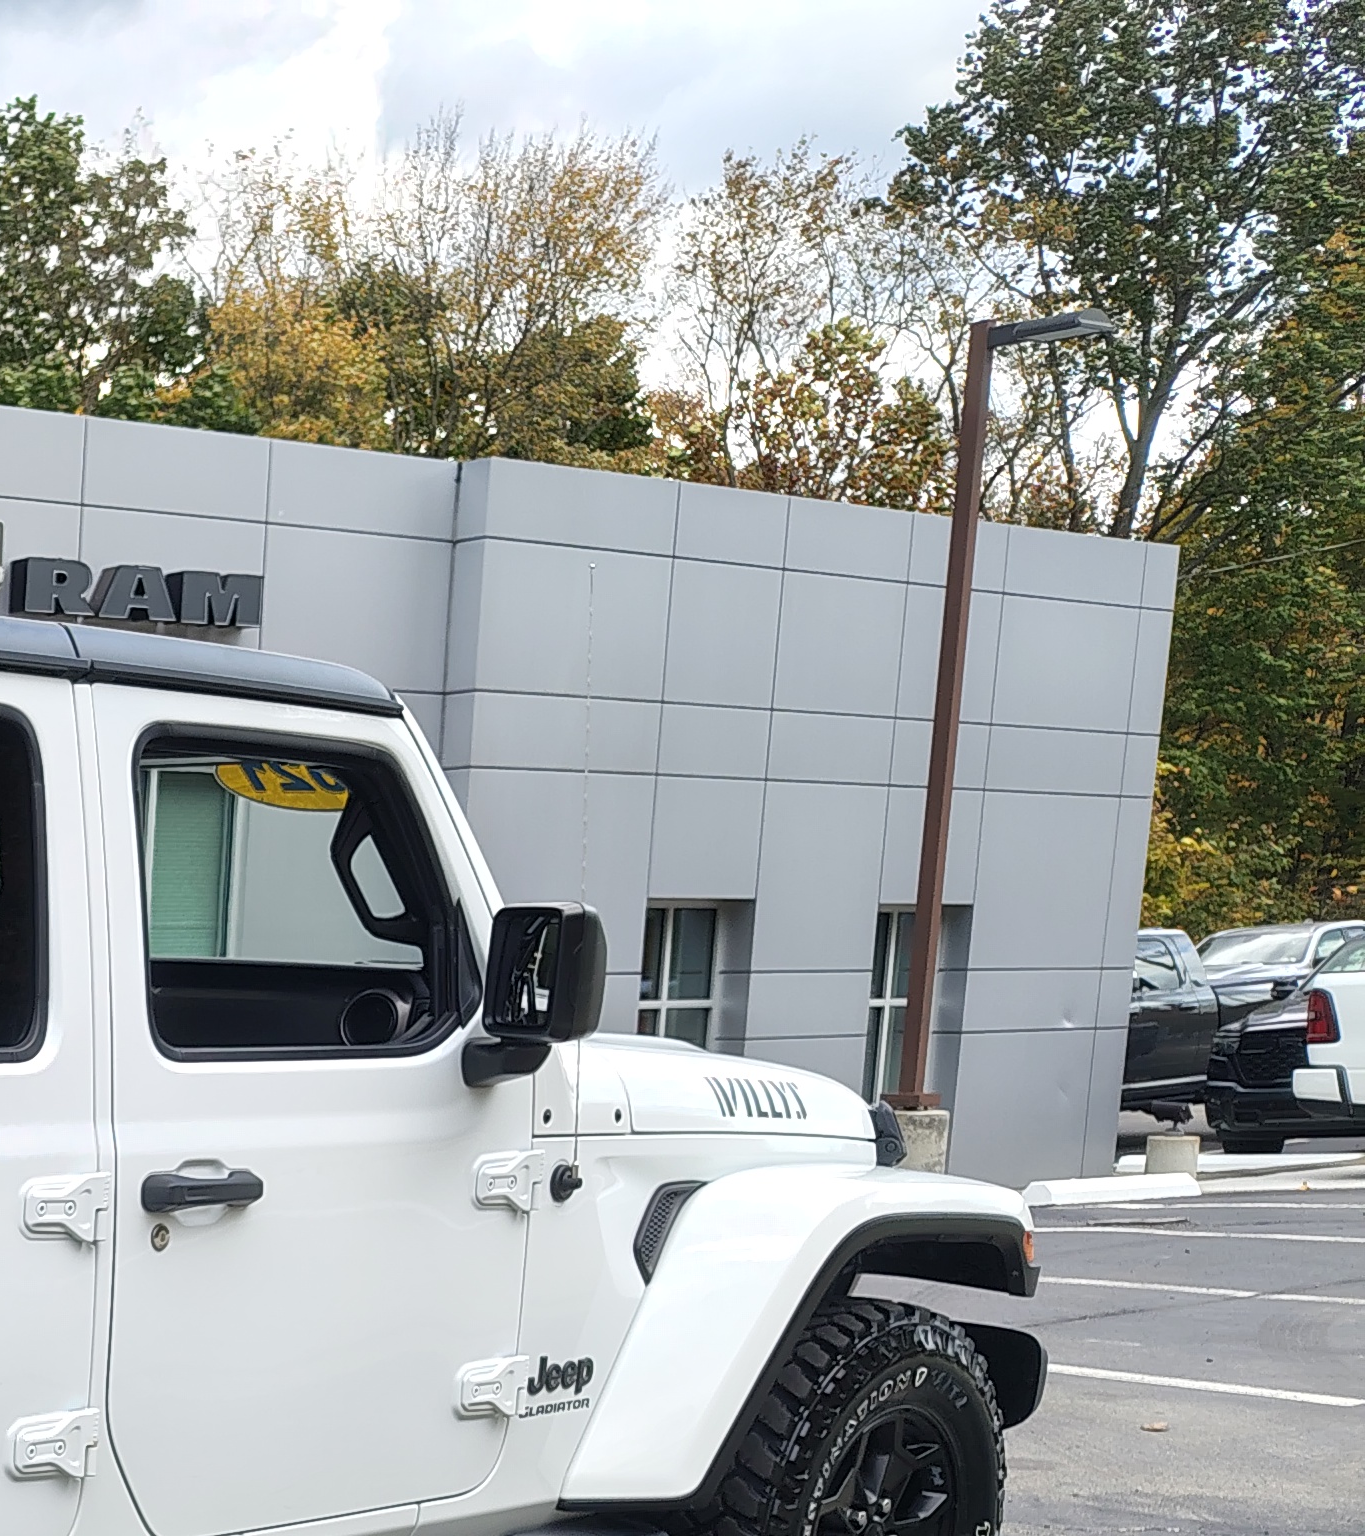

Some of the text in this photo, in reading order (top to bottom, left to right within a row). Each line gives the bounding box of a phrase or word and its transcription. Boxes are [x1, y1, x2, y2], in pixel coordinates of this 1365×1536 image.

[10, 557, 260, 628] RAM
[703, 1076, 807, 1120] WILLYS
[527, 1356, 593, 1395] Jeep
